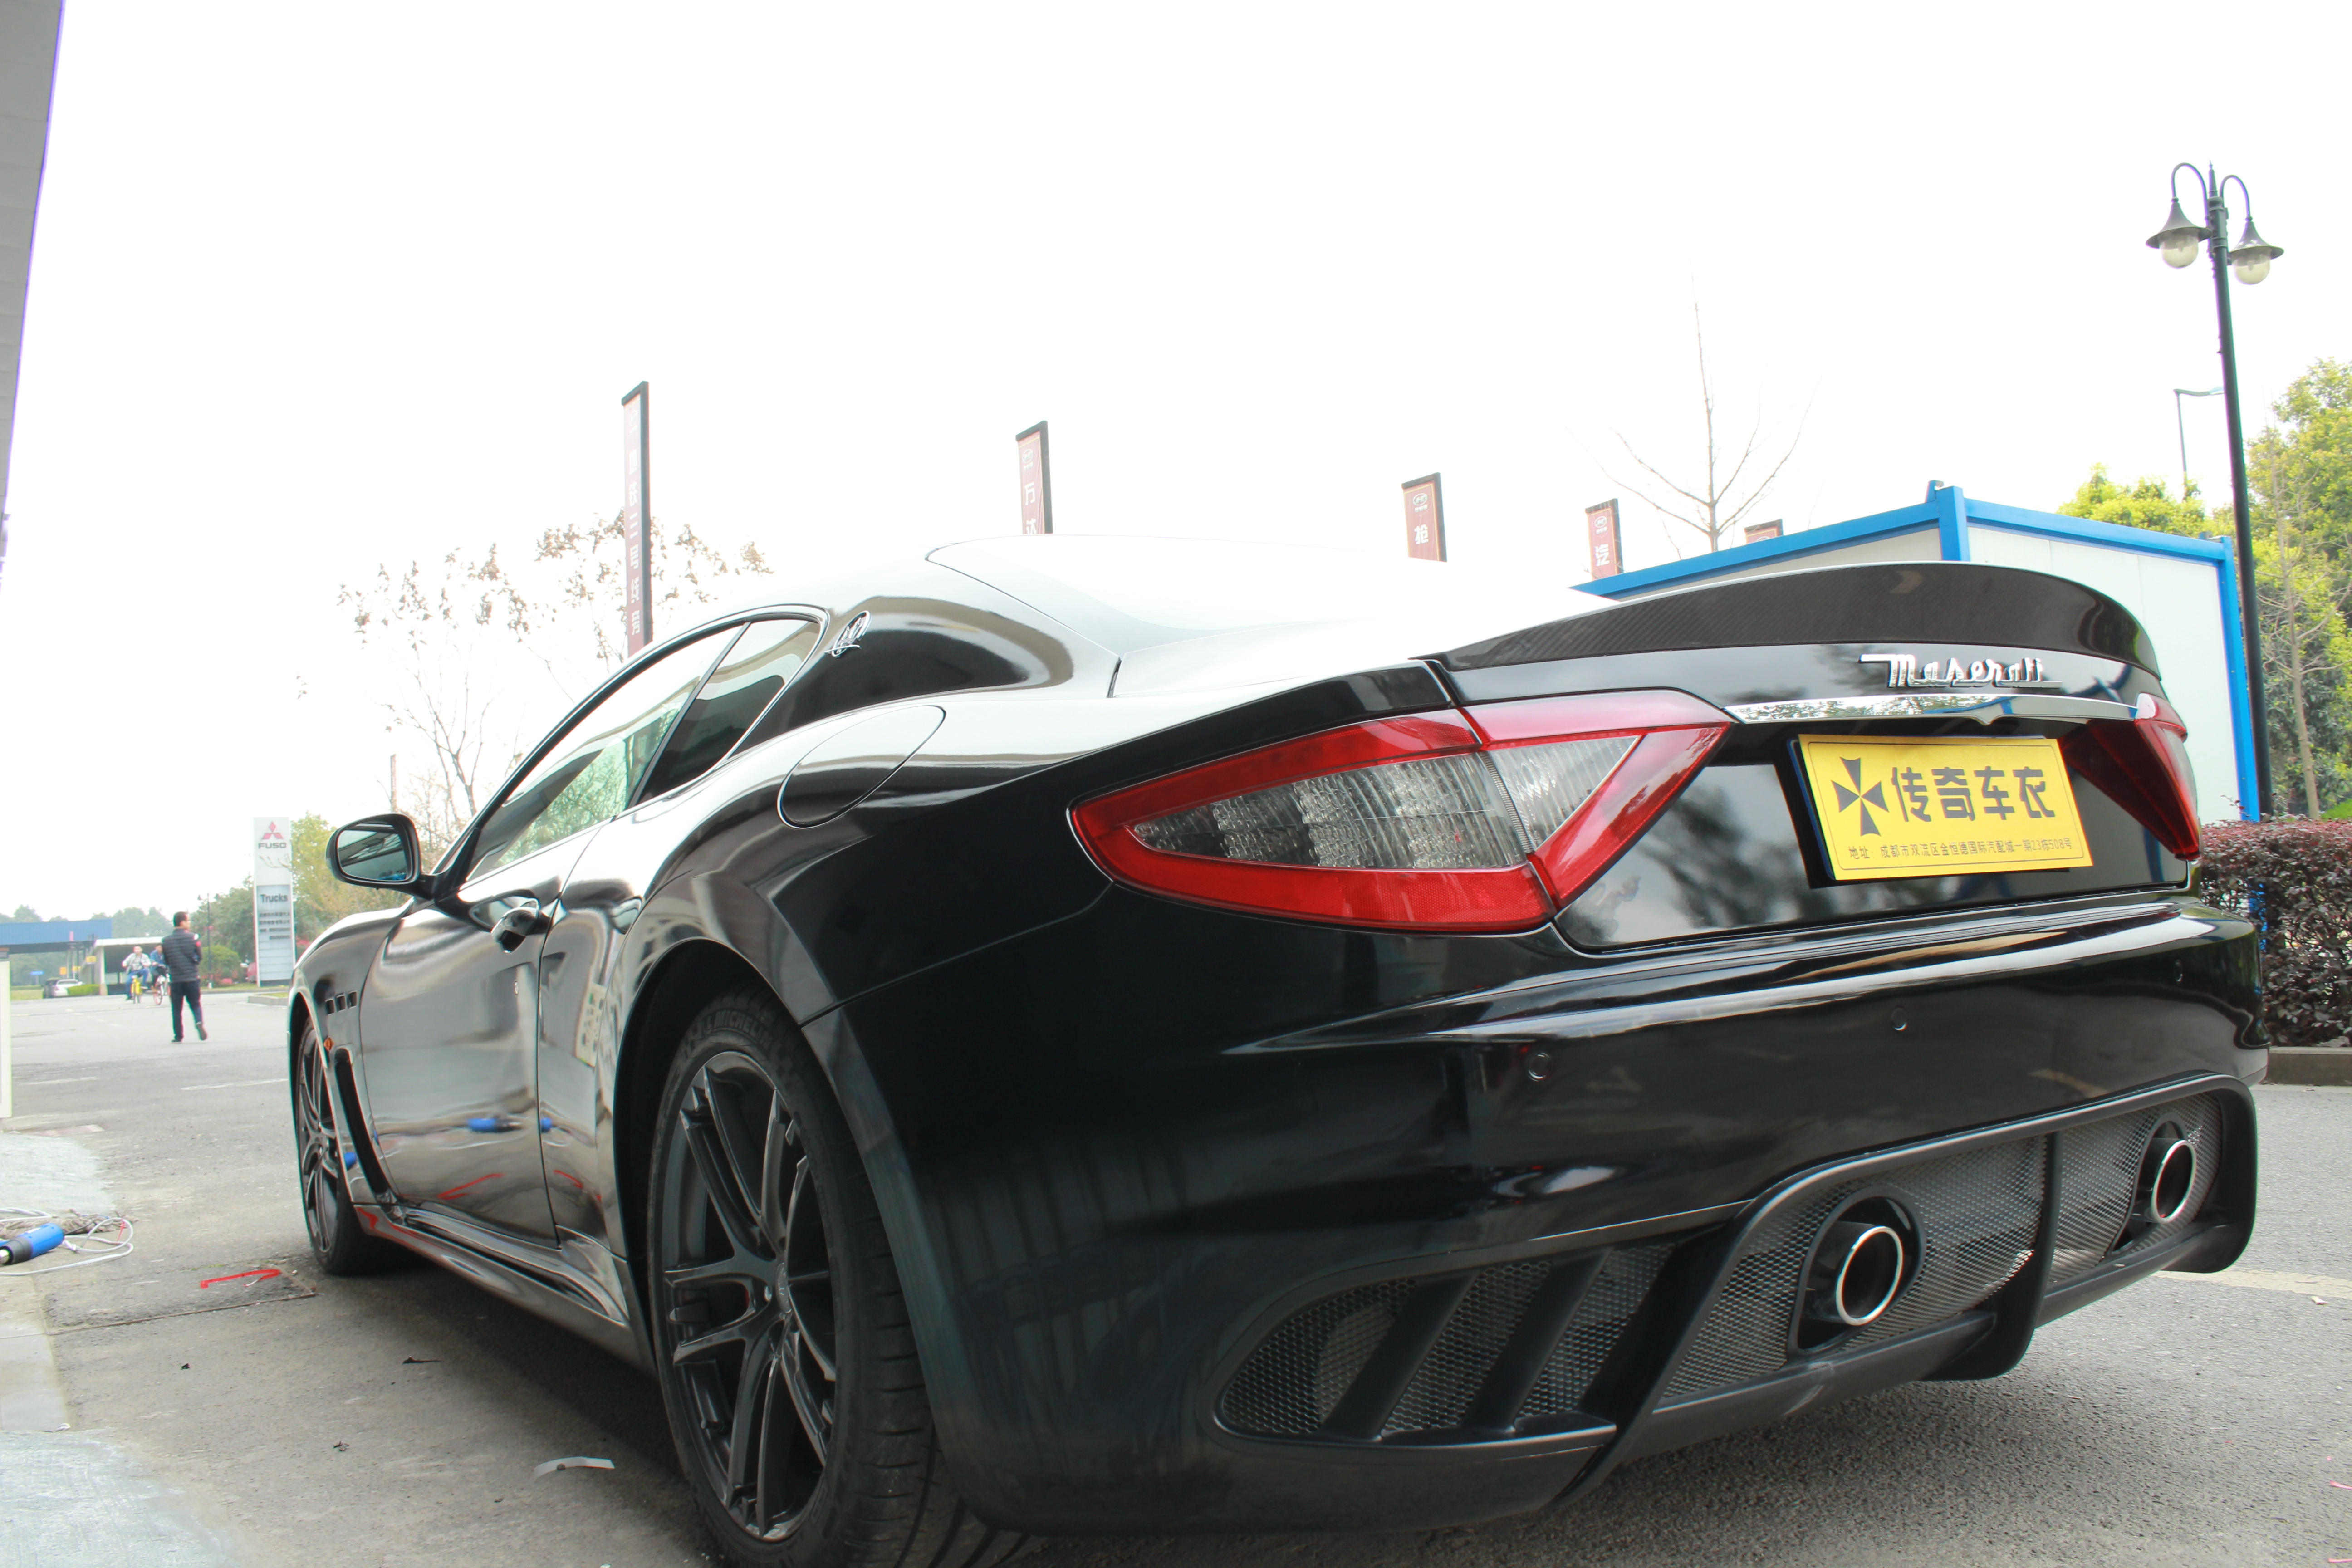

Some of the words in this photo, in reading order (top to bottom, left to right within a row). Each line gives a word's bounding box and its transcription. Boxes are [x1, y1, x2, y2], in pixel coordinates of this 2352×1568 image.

[1414, 524, 1429, 544] 抢
[1858, 654, 2063, 687] Maserati
[1891, 766, 2055, 822] 传奇车衣
[260, 893, 288, 902] Trucks
[714, 1010, 774, 1050] MICHELIN
